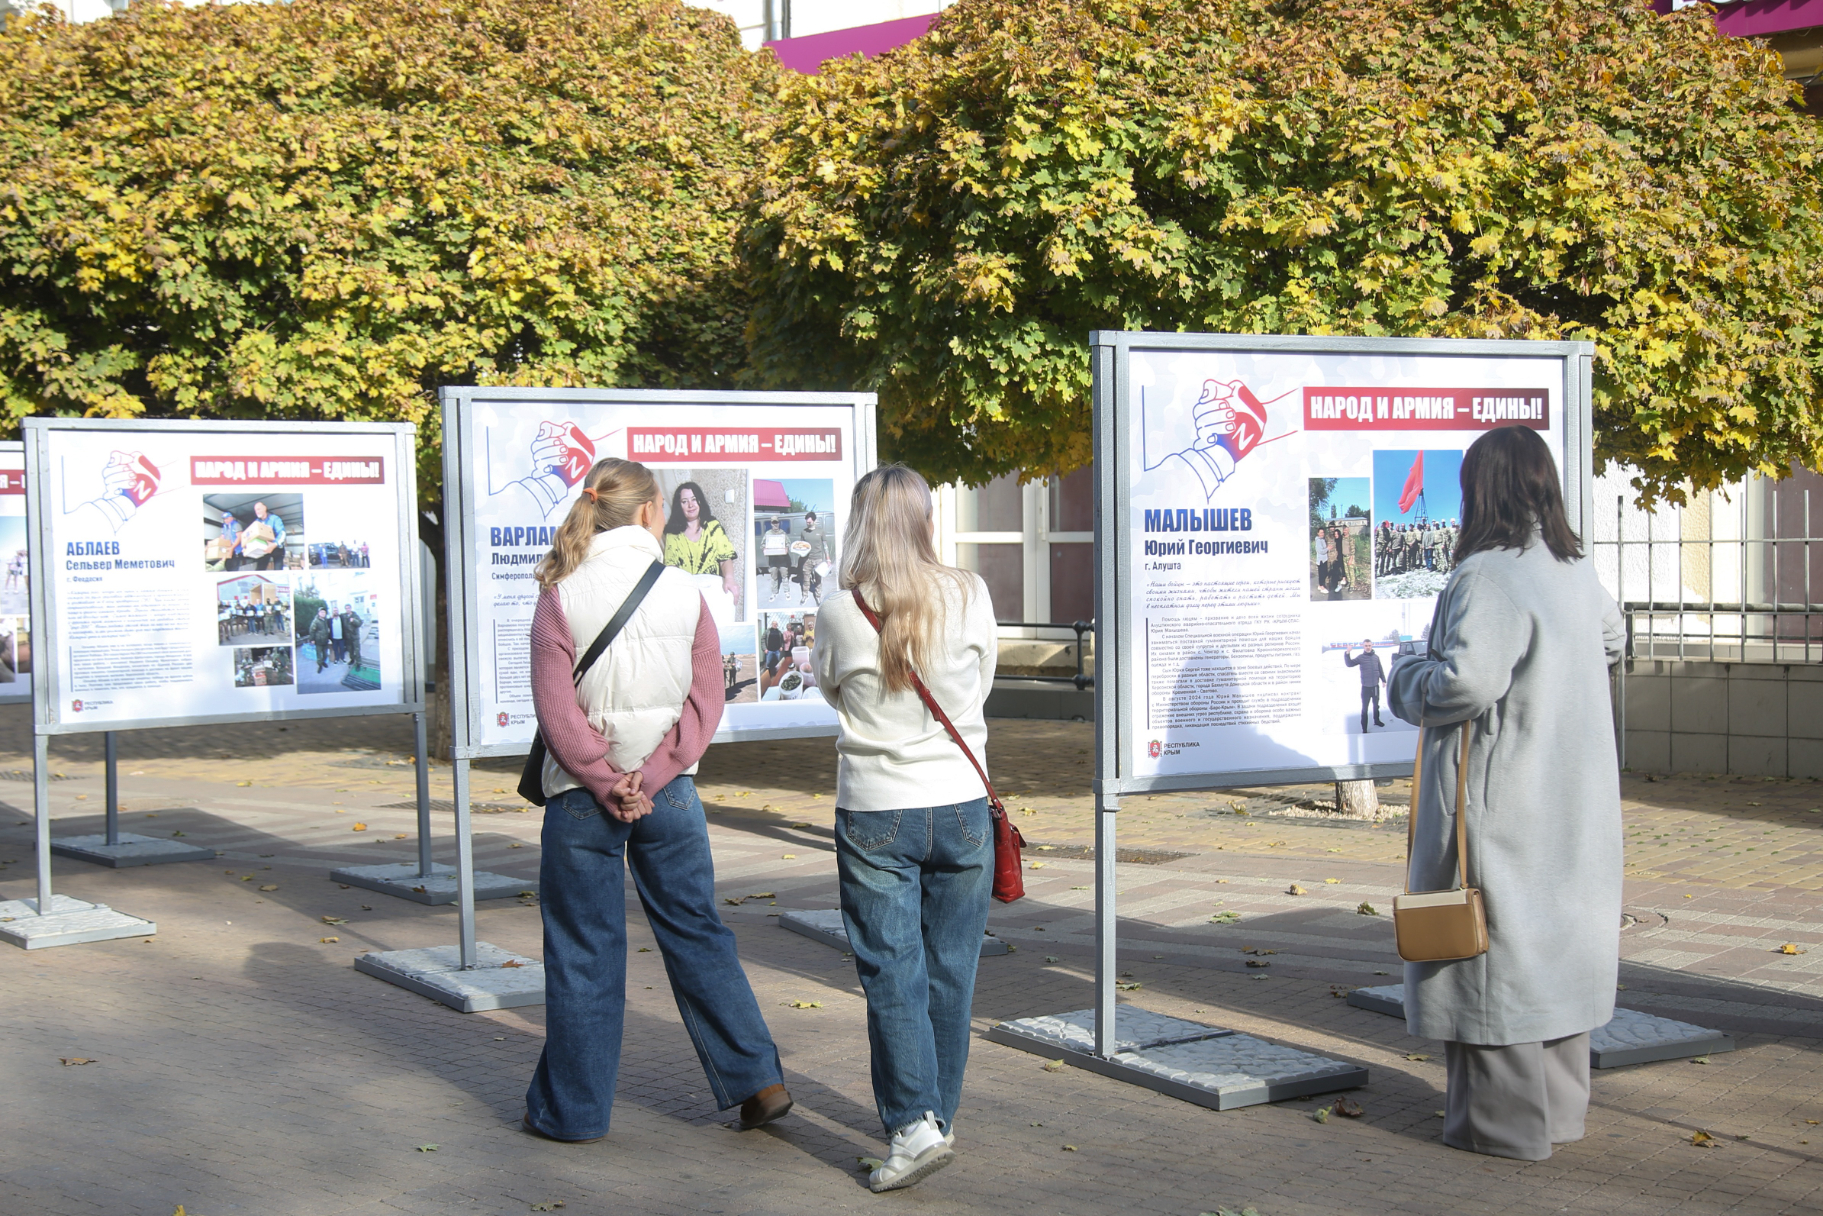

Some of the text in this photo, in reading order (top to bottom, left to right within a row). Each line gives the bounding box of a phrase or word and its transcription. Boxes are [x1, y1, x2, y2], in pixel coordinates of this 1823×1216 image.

[1310, 396, 1374, 423] НАРОД
[1376, 396, 1389, 420] И
[1392, 396, 1454, 420] АРМИЯ
[1472, 397, 1543, 423] ЕДИНЫ!
[633, 434, 688, 456] НАРОД
[691, 434, 702, 453] И
[704, 434, 759, 453] АРМИЯ
[774, 434, 836, 456] ЕДИНЫ!
[194, 461, 246, 480] НАРОД
[248, 461, 258, 478] И
[260, 461, 310, 478] АРМИЯ
[324, 461, 380, 480] ЕДИНЫ!
[1144, 508, 1252, 532] МАЛЫШЕВ
[66, 541, 120, 556] АБЛАЕВ
[1144, 538, 1268, 557] Юрий Георгиевич
[66, 558, 175, 570] Сельвер Меметович
[491, 552, 547, 566] Людмил
[1144, 561, 1182, 572] г. Алушта
